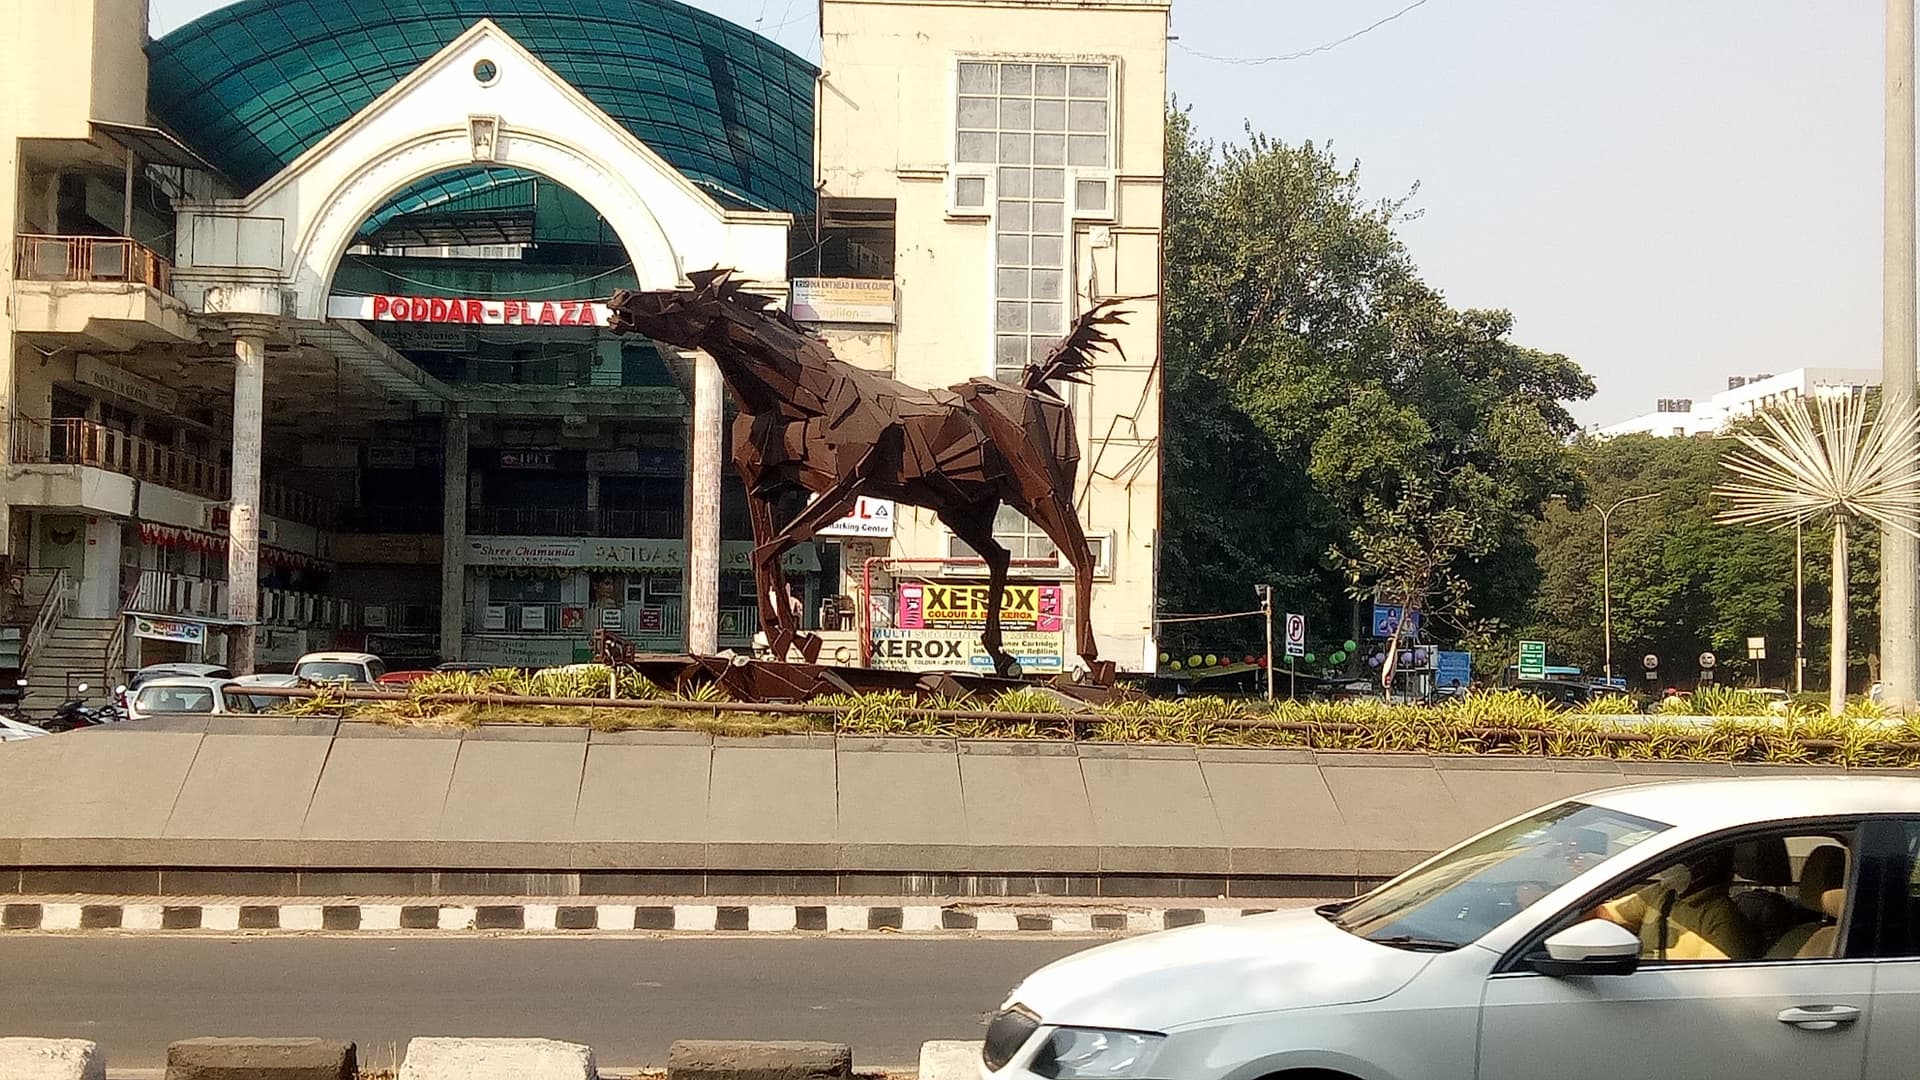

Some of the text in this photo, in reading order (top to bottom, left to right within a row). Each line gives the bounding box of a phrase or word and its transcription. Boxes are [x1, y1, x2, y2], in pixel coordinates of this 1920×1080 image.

[861, 523, 889, 533] Center
[480, 546, 576, 558] Shree Chamunda
[928, 610, 968, 619] COLOUR
[1000, 611, 1032, 620] XEROX
[872, 629, 912, 639] MULTI
[871, 639, 962, 658] XEROX
[1021, 640, 1058, 650] Cartridge
